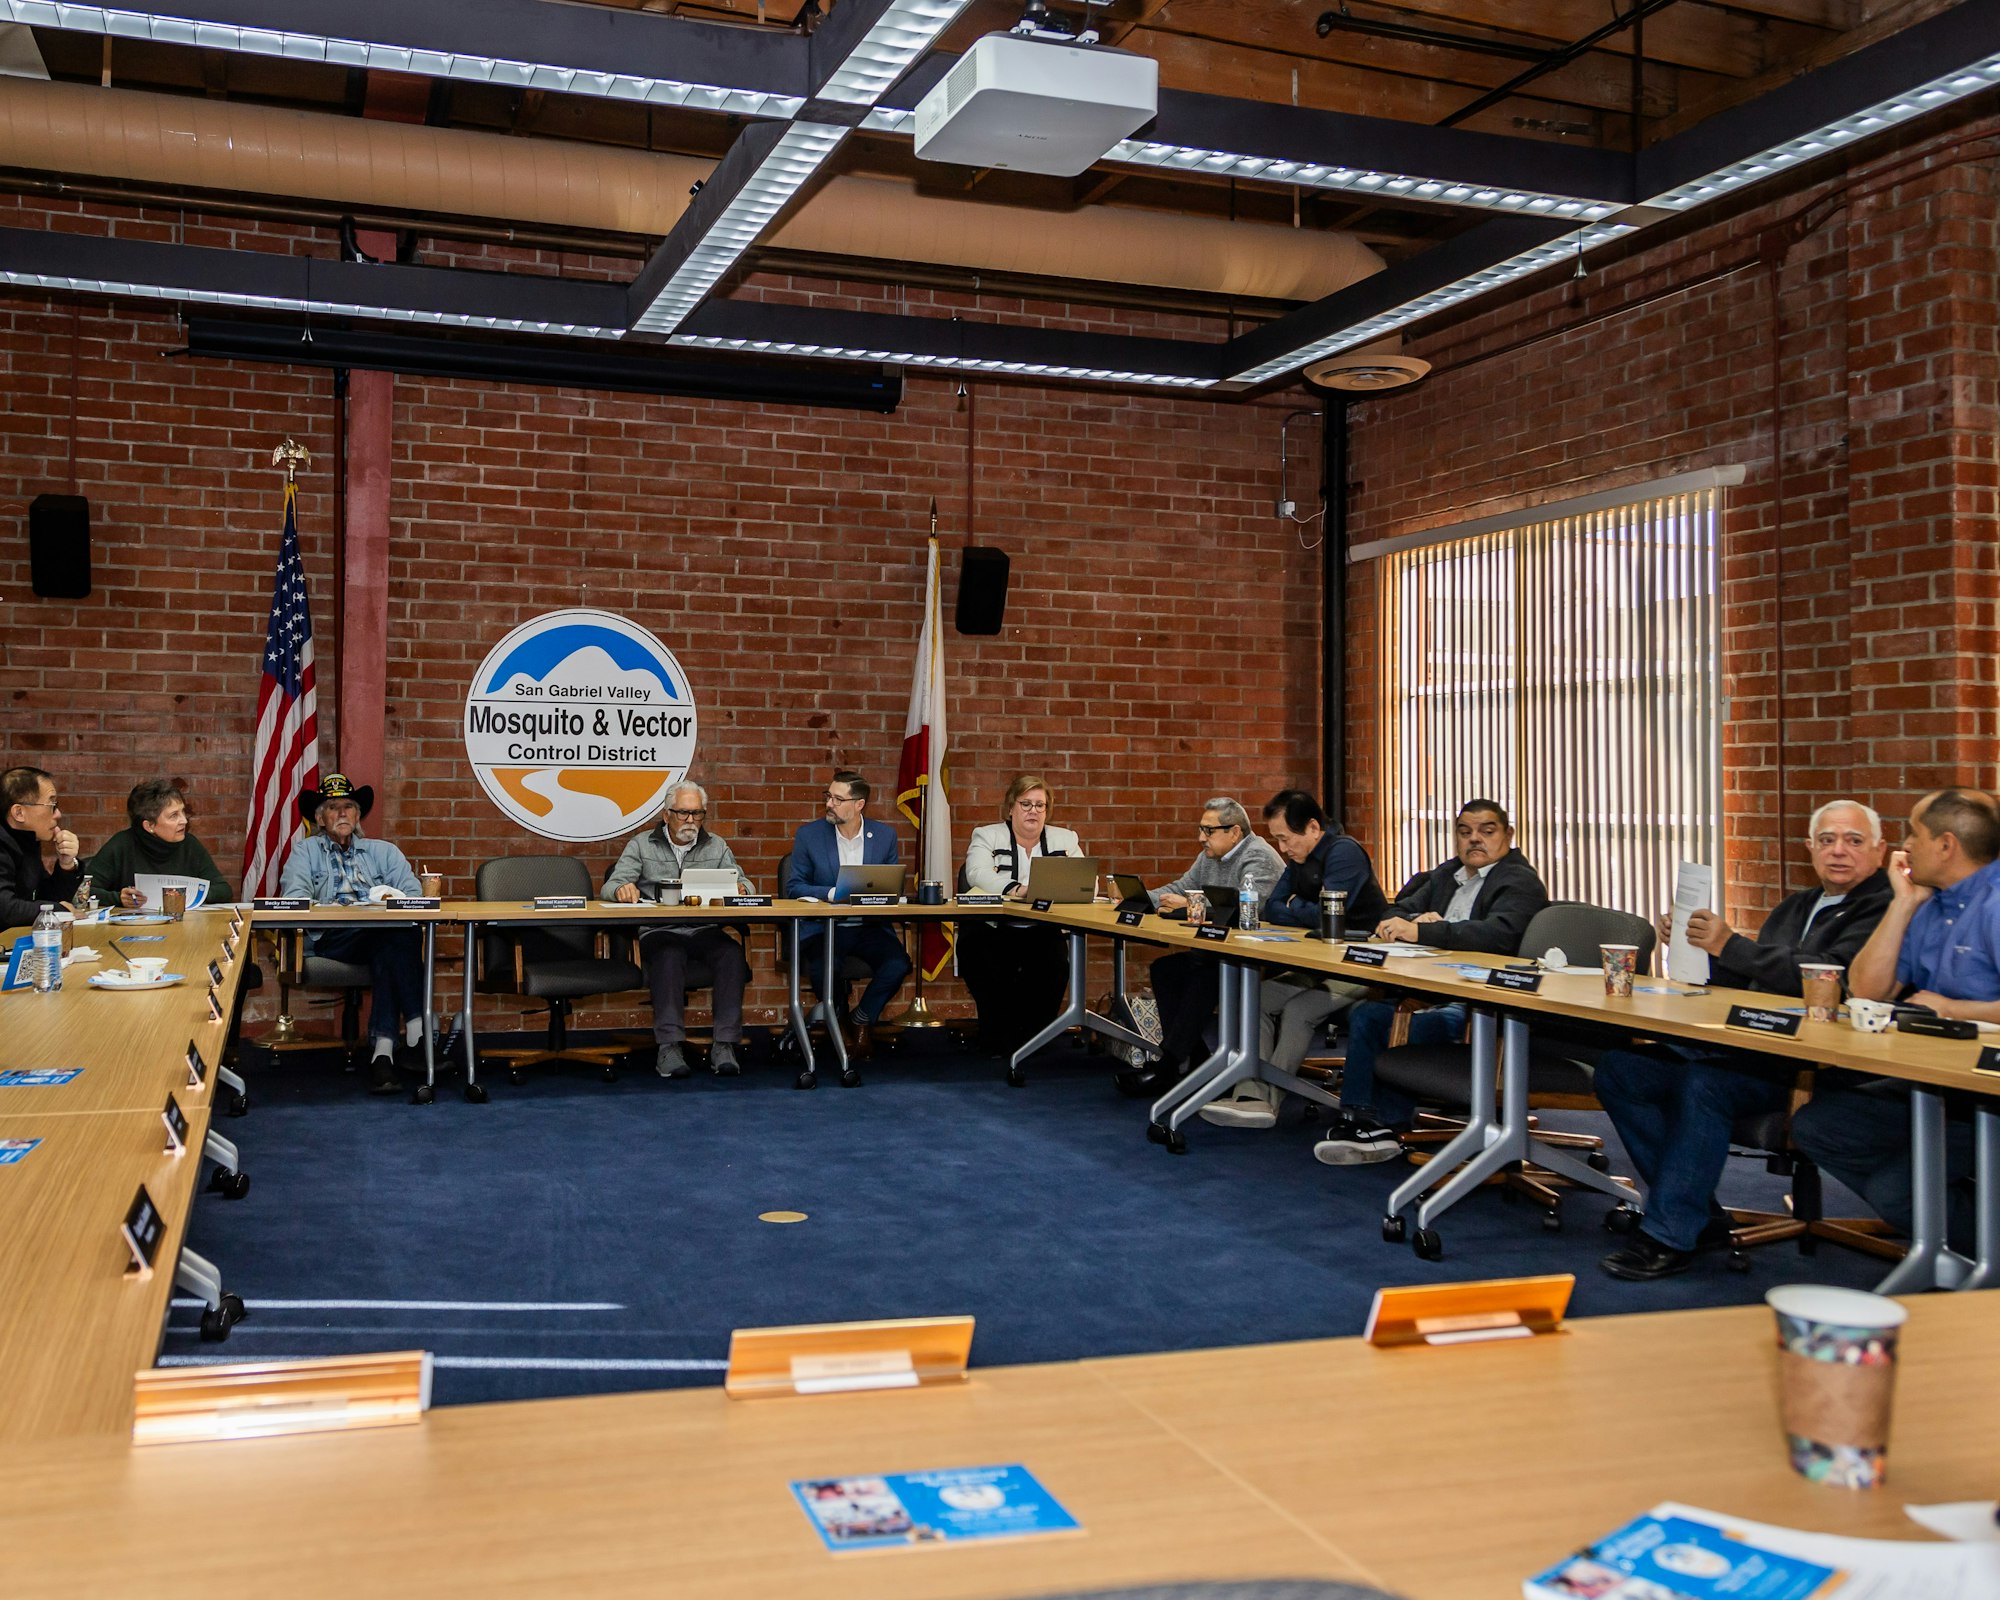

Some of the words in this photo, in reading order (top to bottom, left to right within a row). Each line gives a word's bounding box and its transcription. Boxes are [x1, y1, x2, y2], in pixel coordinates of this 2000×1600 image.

[515, 683, 543, 697] San
[548, 684, 602, 698] Gabriel
[607, 686, 651, 702] Valley
[469, 705, 584, 742] Mosquito
[592, 708, 610, 736] &
[617, 708, 692, 738] Vector
[508, 743, 581, 761] Control
[587, 745, 657, 762] District
